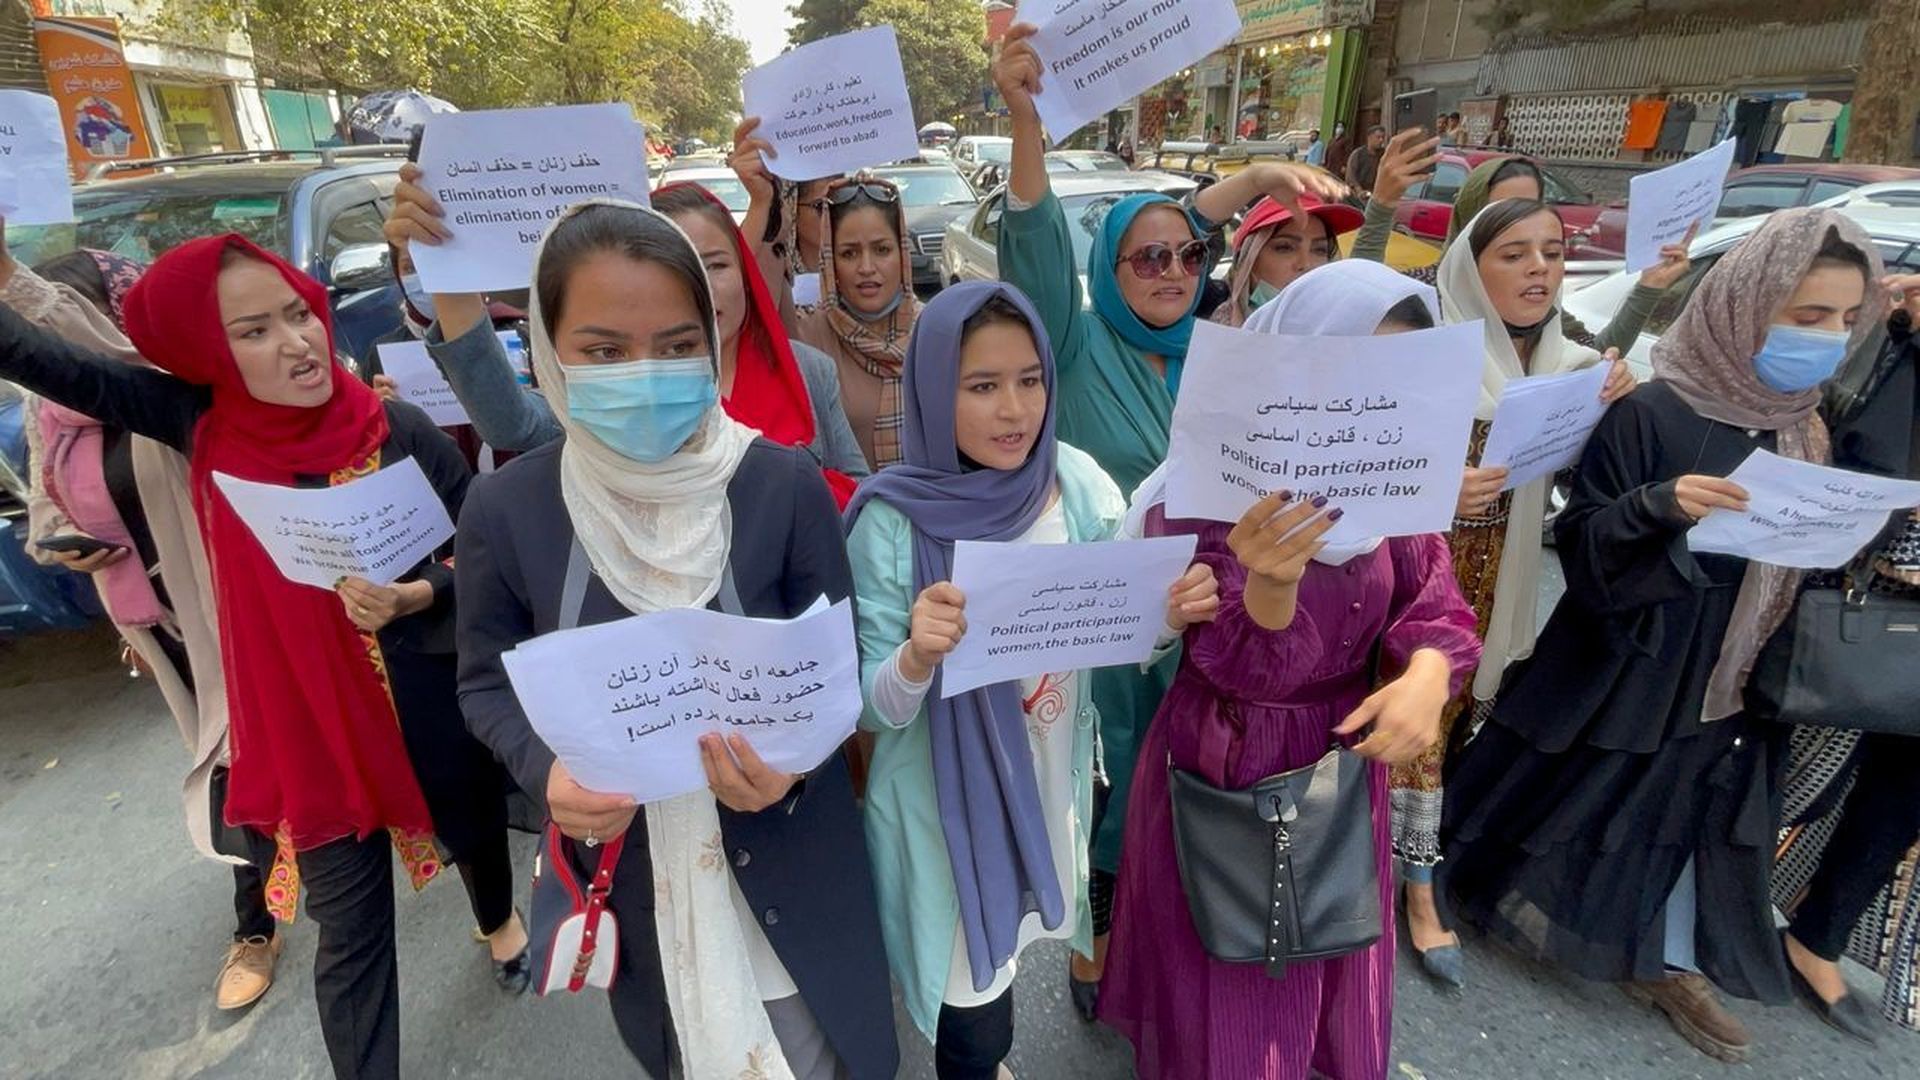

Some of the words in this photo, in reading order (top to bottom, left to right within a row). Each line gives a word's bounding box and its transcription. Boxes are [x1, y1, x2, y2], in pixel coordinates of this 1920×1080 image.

[1051, 35, 1110, 75] Freedom
[1111, 26, 1124, 40] is
[1125, 14, 1148, 32] our
[1152, 0, 1180, 16] mo
[1073, 77, 1085, 91] It
[1087, 54, 1129, 84] makes
[1132, 43, 1147, 57] us
[1150, 15, 1191, 49] proud
[784, 110, 807, 120] حرکت
[798, 136, 838, 154] Forward
[840, 136, 851, 145] to
[852, 129, 878, 143] abadi
[447, 161, 482, 178] انسان
[487, 158, 518, 173] حذف
[538, 157, 567, 173] زنان
[571, 152, 601, 169] حذف
[438, 186, 527, 203] Elimination
[531, 183, 548, 198] of
[550, 182, 607, 196] women
[455, 208, 542, 225] elimination
[546, 206, 560, 220] of
[518, 230, 542, 244] bei
[1257, 395, 1318, 415] سیاسی
[1325, 394, 1397, 416] مشارکت
[1246, 427, 1300, 444] اساسی
[1307, 426, 1356, 448] قانون
[1376, 426, 1403, 445] زن
[1220, 443, 1288, 476] Political
[1294, 454, 1428, 480] participation
[1326, 482, 1377, 499] basic
[1382, 481, 1421, 497] law
[340, 547, 355, 559] all
[356, 526, 412, 559] together
[371, 526, 435, 570] oppression
[1031, 583, 1075, 598] سیاسی
[1079, 579, 1128, 593] مشارکت
[1018, 602, 1059, 618] اساسی
[1063, 598, 1096, 613] قانون
[1108, 598, 1128, 609] زن
[990, 620, 1051, 637] Political
[1051, 613, 1141, 634] participation
[987, 636, 1069, 657] women,the
[1072, 632, 1107, 647] basic
[1109, 631, 1135, 643] law
[657, 652, 680, 676] آن
[689, 655, 709, 670] در
[713, 657, 731, 674] که
[767, 657, 820, 680] جامعه
[607, 664, 652, 691] زنان
[738, 665, 760, 681] ای
[667, 676, 721, 698] نداشته
[726, 686, 762, 704] فعال
[771, 680, 825, 705] حضور
[611, 693, 661, 714] باشند
[725, 713, 777, 728] جامعه
[784, 708, 815, 723] یک
[627, 714, 677, 743] است!
